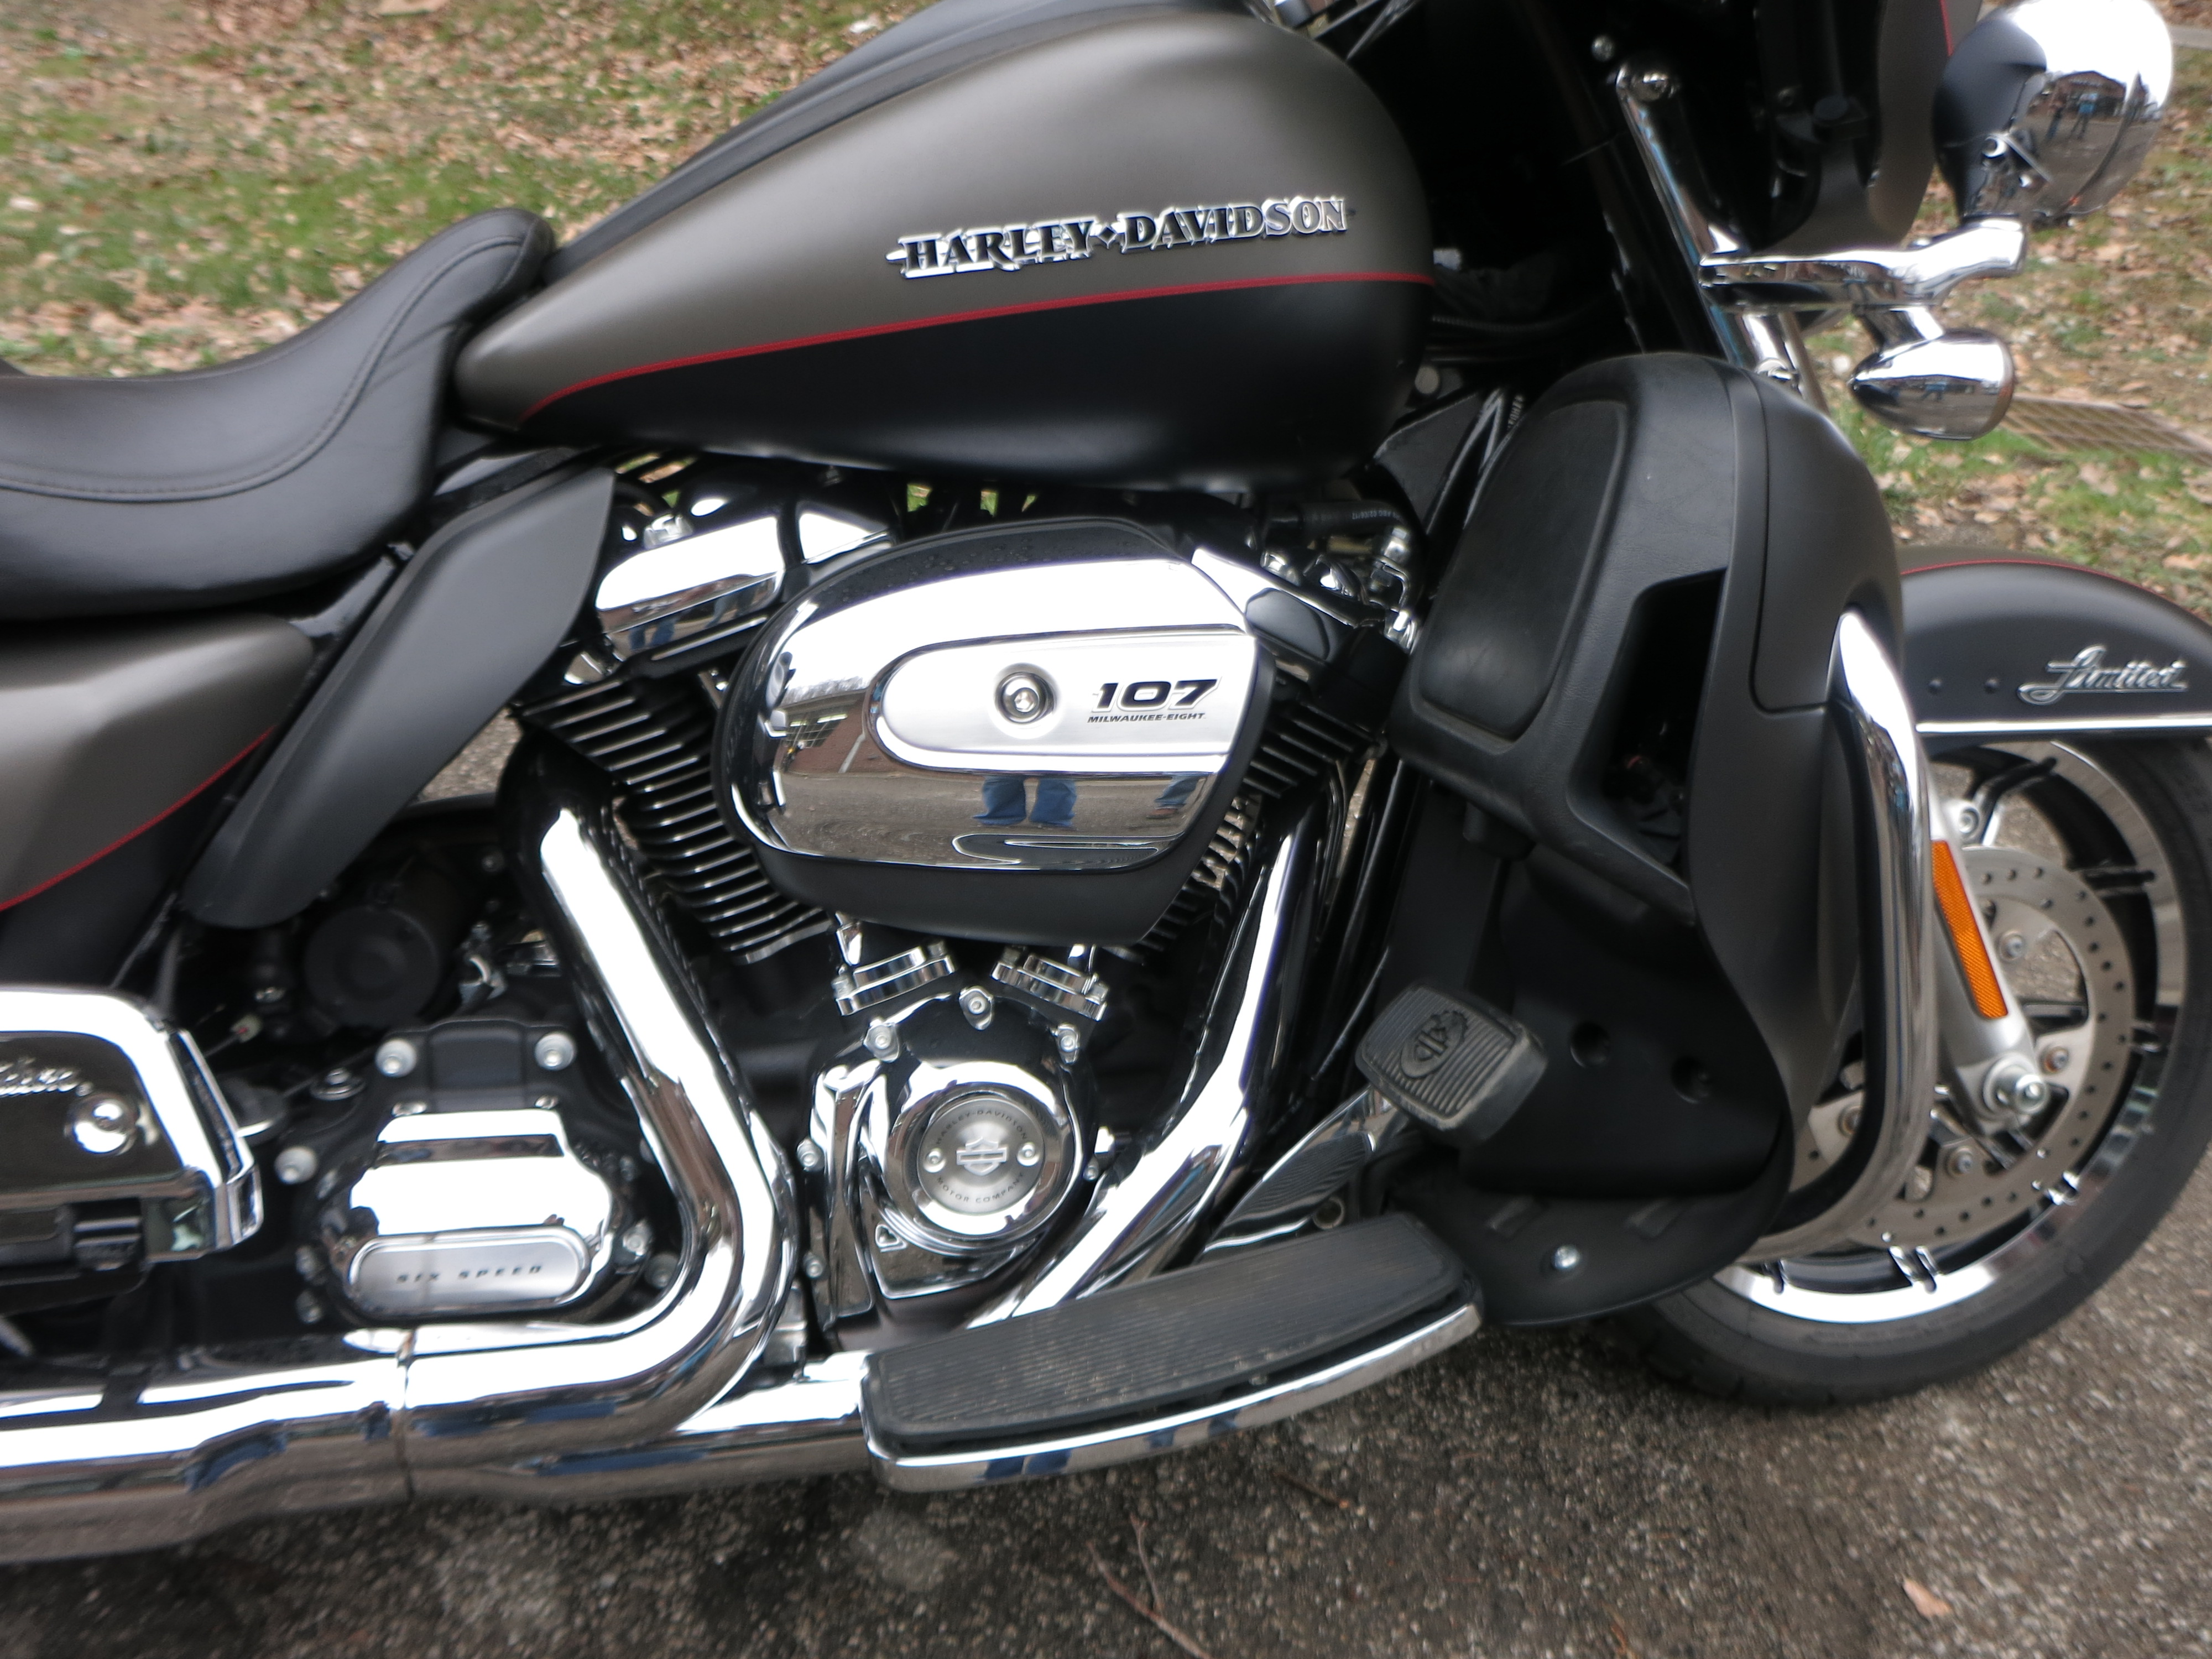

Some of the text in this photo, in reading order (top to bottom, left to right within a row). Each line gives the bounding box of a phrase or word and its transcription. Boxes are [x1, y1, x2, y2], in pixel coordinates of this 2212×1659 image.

[1093, 679, 1219, 712] 107
[1087, 712, 1206, 723] MILWAUKEE-EIGHT
[935, 1109, 1028, 1146] HARLEY-DAVIDSON
[936, 1171, 1024, 1204] MOTOR COMPANY
